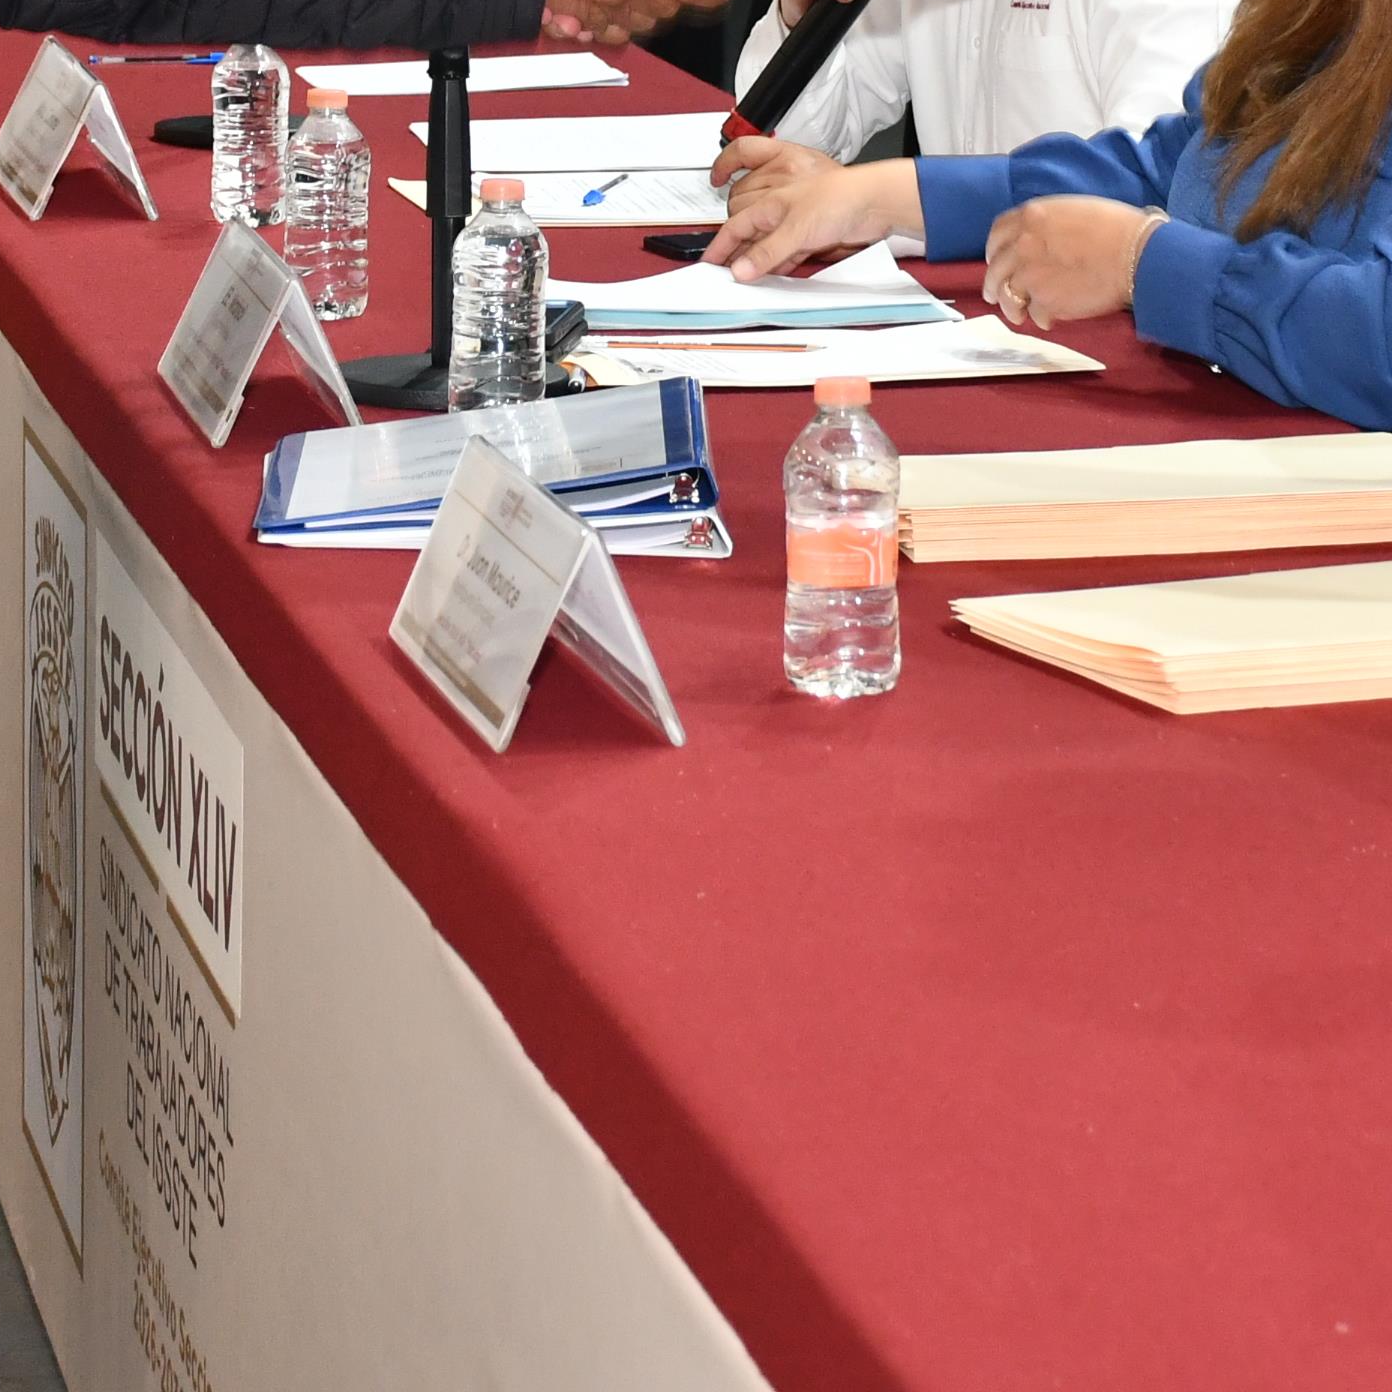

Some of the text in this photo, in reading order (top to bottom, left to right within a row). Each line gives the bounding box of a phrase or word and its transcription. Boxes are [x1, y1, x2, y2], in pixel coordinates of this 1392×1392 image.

[100, 614, 237, 953] SECCIÓN XLIV
[99, 836, 234, 1148] SINDICATO NACIONAL
[105, 929, 225, 1229] DE TRABAJADORES
[99, 1126, 130, 1236] Comité
[132, 1199, 177, 1341] Ejecutivo
[127, 1061, 198, 1270] DEL ISSSTE
